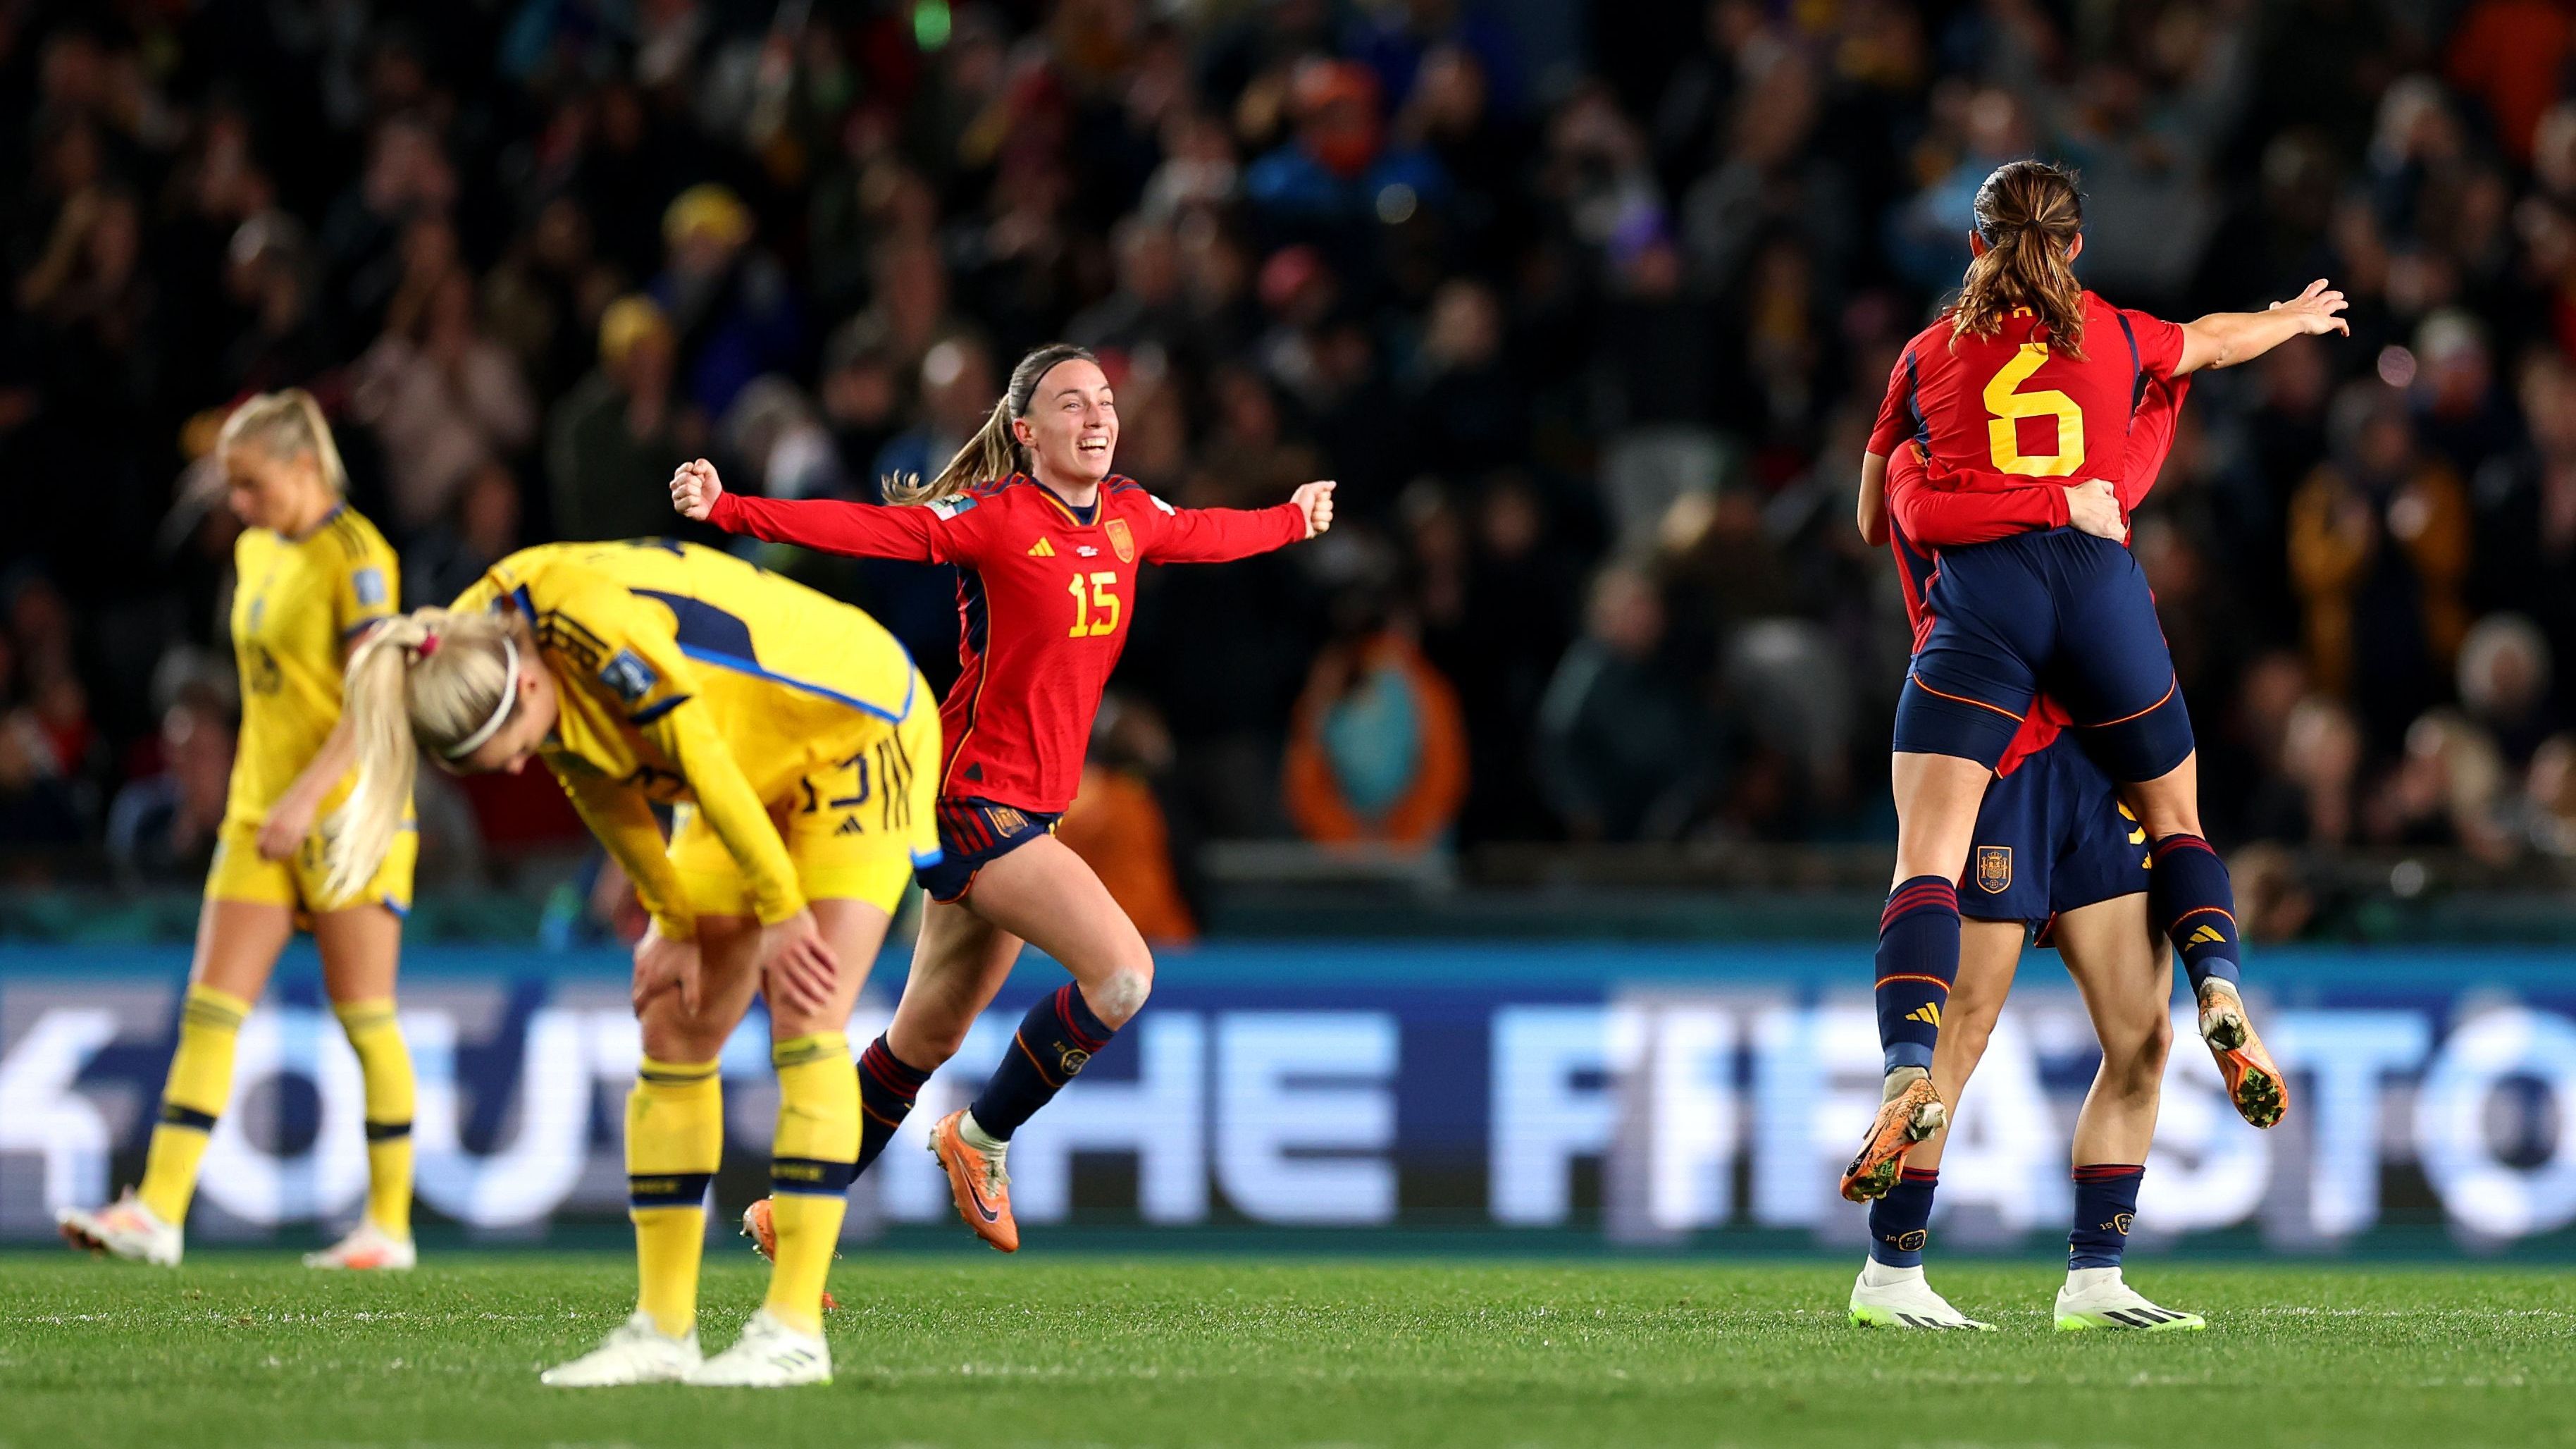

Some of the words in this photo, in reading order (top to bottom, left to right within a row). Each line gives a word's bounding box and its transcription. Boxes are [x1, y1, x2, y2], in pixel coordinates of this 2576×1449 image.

[1983, 342, 2085, 477] 6
[1067, 571, 1121, 639] 15
[842, 1009, 1398, 1226] THE
